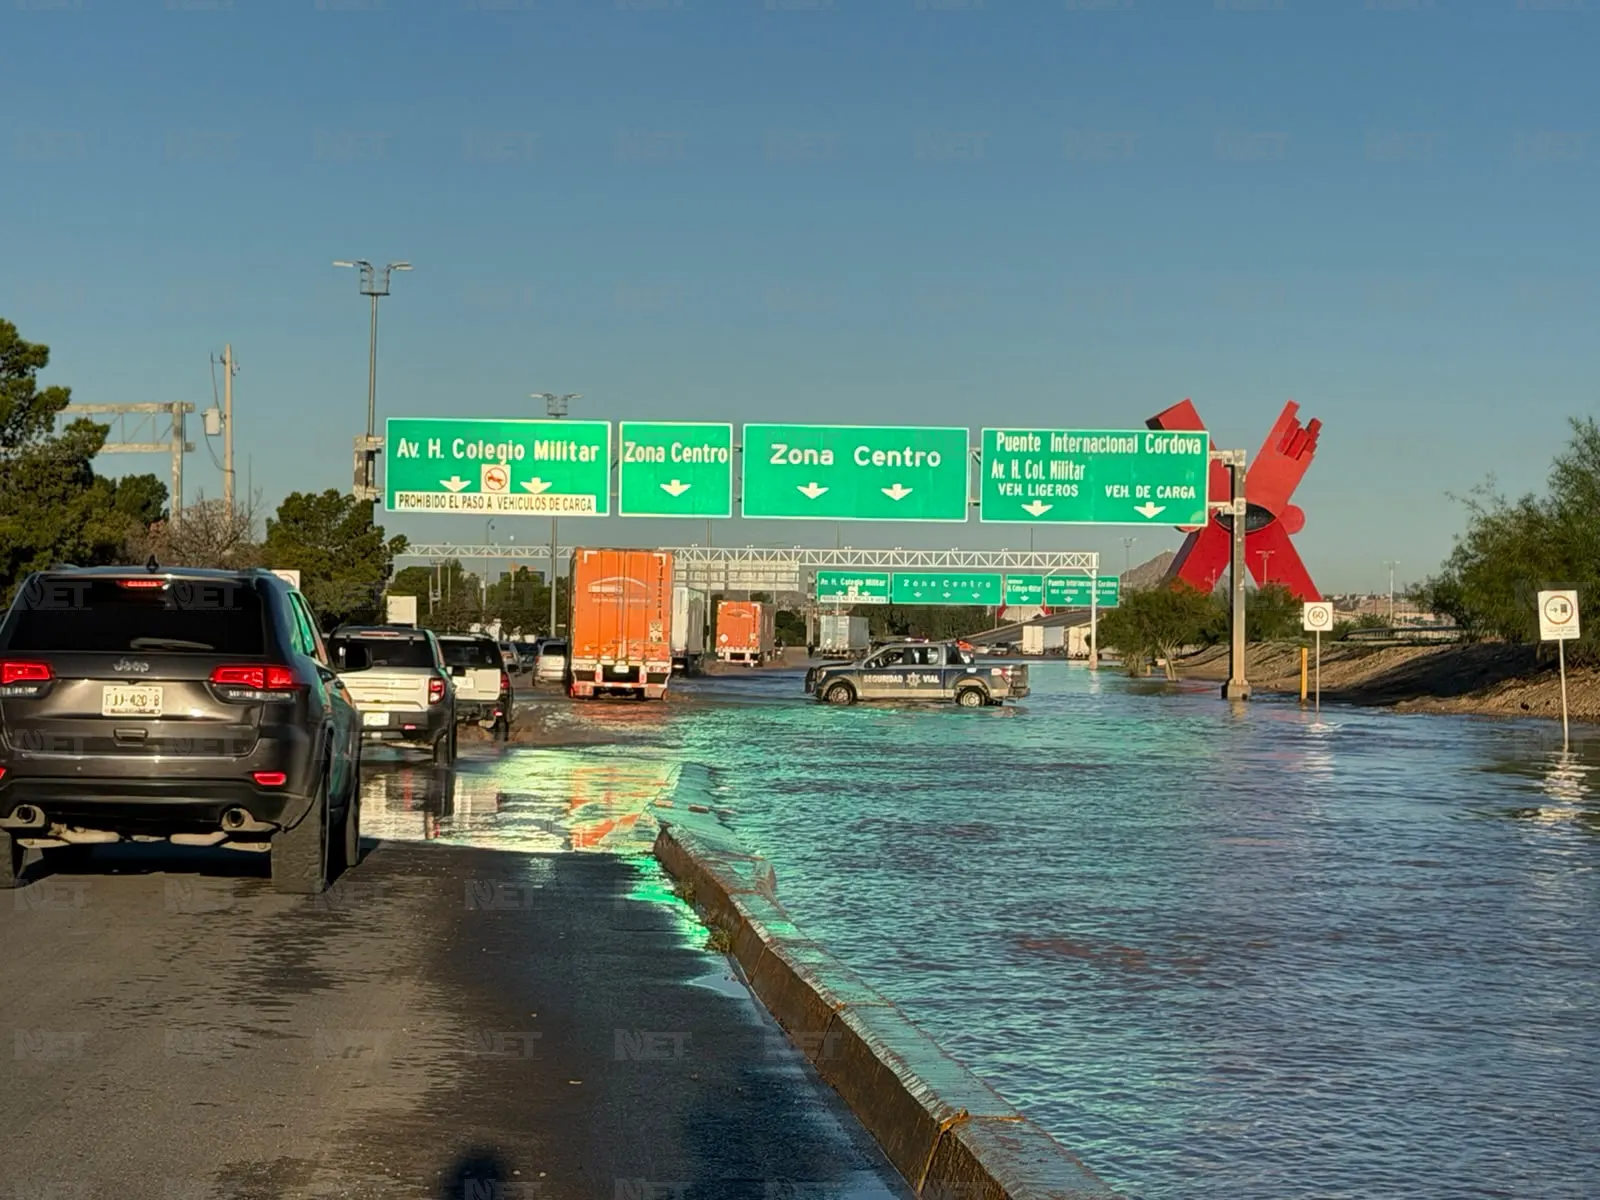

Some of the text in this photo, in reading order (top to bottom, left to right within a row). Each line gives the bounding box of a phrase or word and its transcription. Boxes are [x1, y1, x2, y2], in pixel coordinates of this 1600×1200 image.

[396, 438, 600, 465] Av. H. Colegio Militar
[996, 431, 1041, 452] Puente
[1051, 432, 1138, 454] Internacional
[624, 441, 728, 464] Zona Centro
[770, 443, 941, 468] Zona Centro
[991, 458, 1005, 479] Av.
[1011, 459, 1021, 479] H.
[1050, 459, 1085, 480] Militar
[1027, 483, 1079, 498] LIGEROS
[1135, 485, 1151, 498] DE
[1156, 485, 1196, 499] CARGA
[398, 493, 593, 512] PROHIBIDO EL PASO A VEHICULOS DE CARGA
[903, 579, 936, 588] Zona
[113, 656, 149, 673] Jeep
[863, 674, 940, 684] SEGURIDAD VIAL
